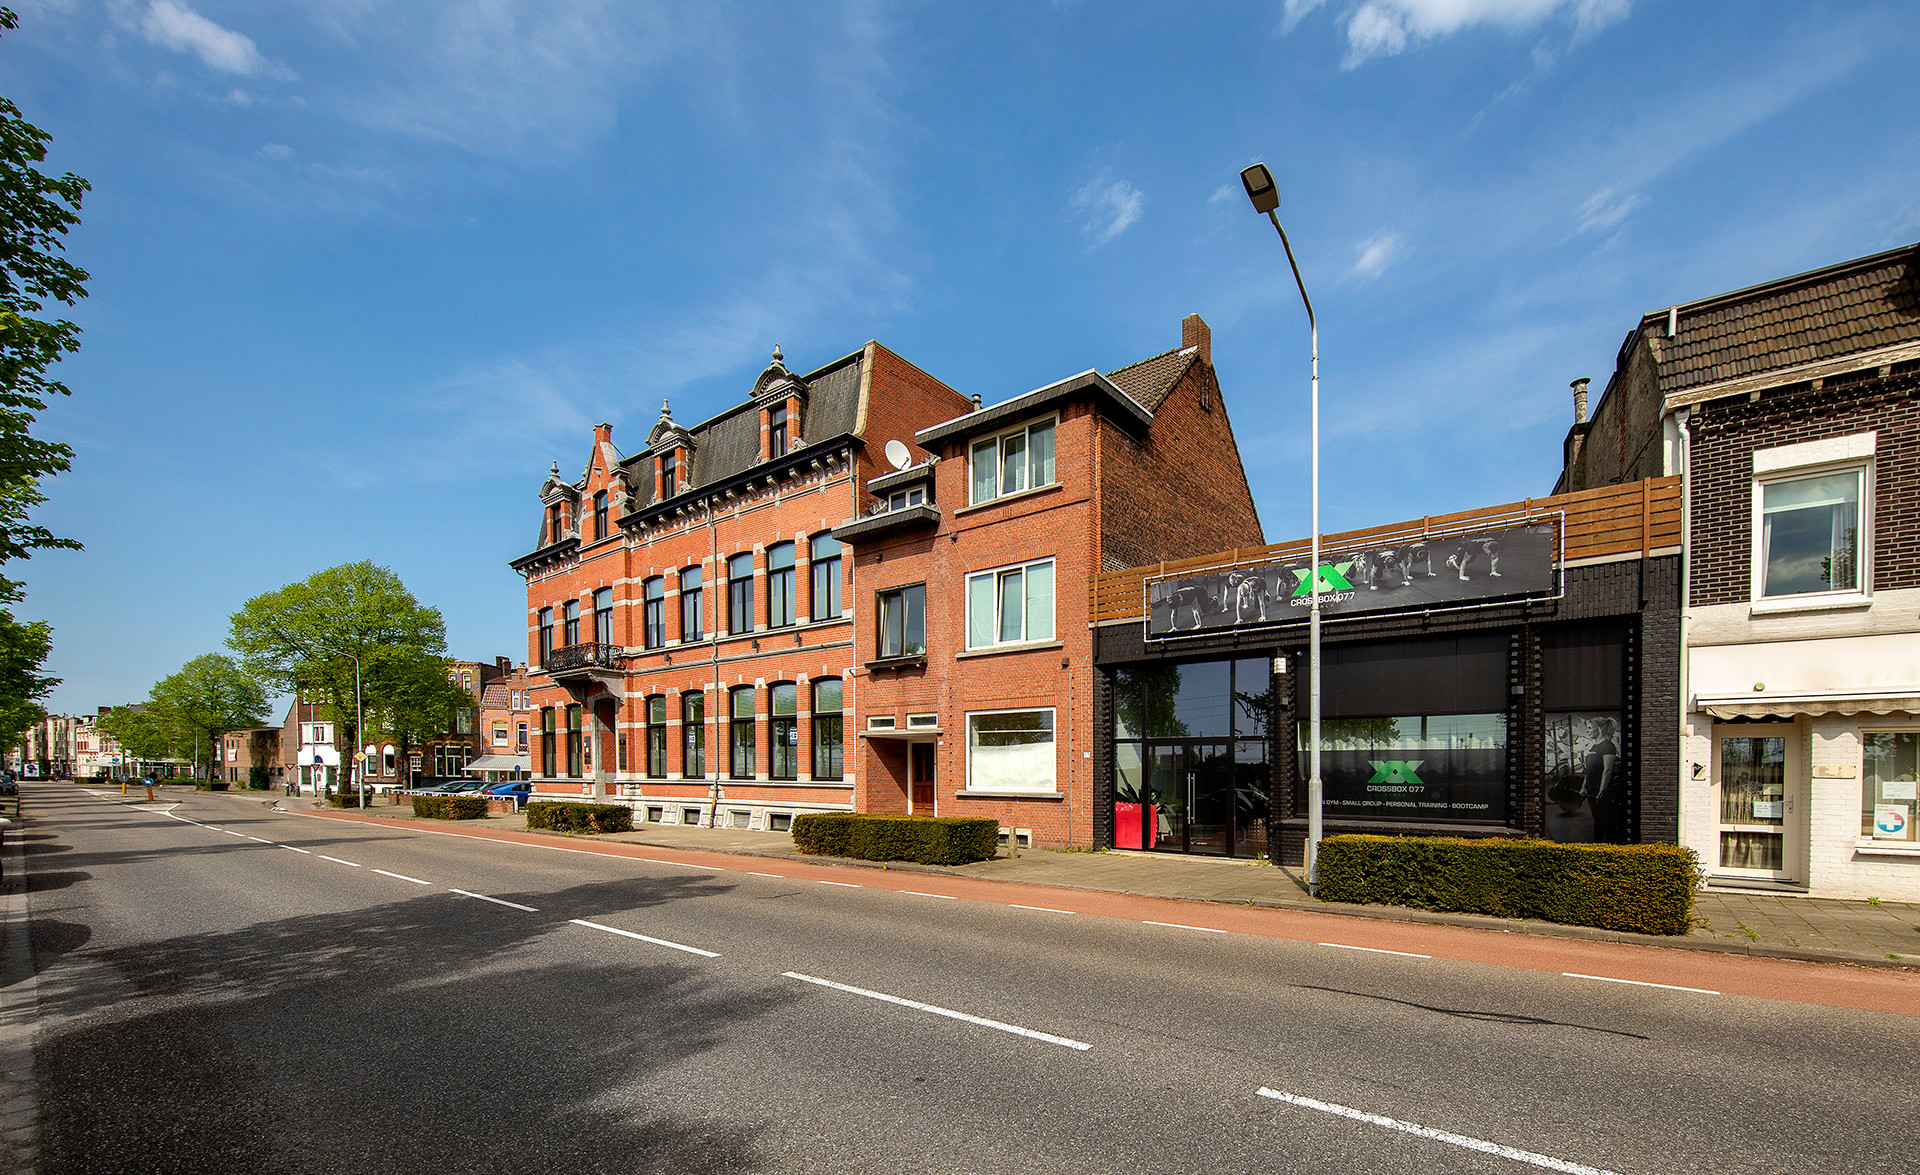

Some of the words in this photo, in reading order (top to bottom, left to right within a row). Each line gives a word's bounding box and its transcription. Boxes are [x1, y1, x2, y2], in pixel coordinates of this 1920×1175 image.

[1290, 594, 1335, 607] CROSBOX
[1337, 591, 1356, 602] 077
[1366, 785, 1408, 793] CROSSBOX
[1408, 785, 1425, 793] 077
[1451, 802, 1489, 810] BOOTCAMP
